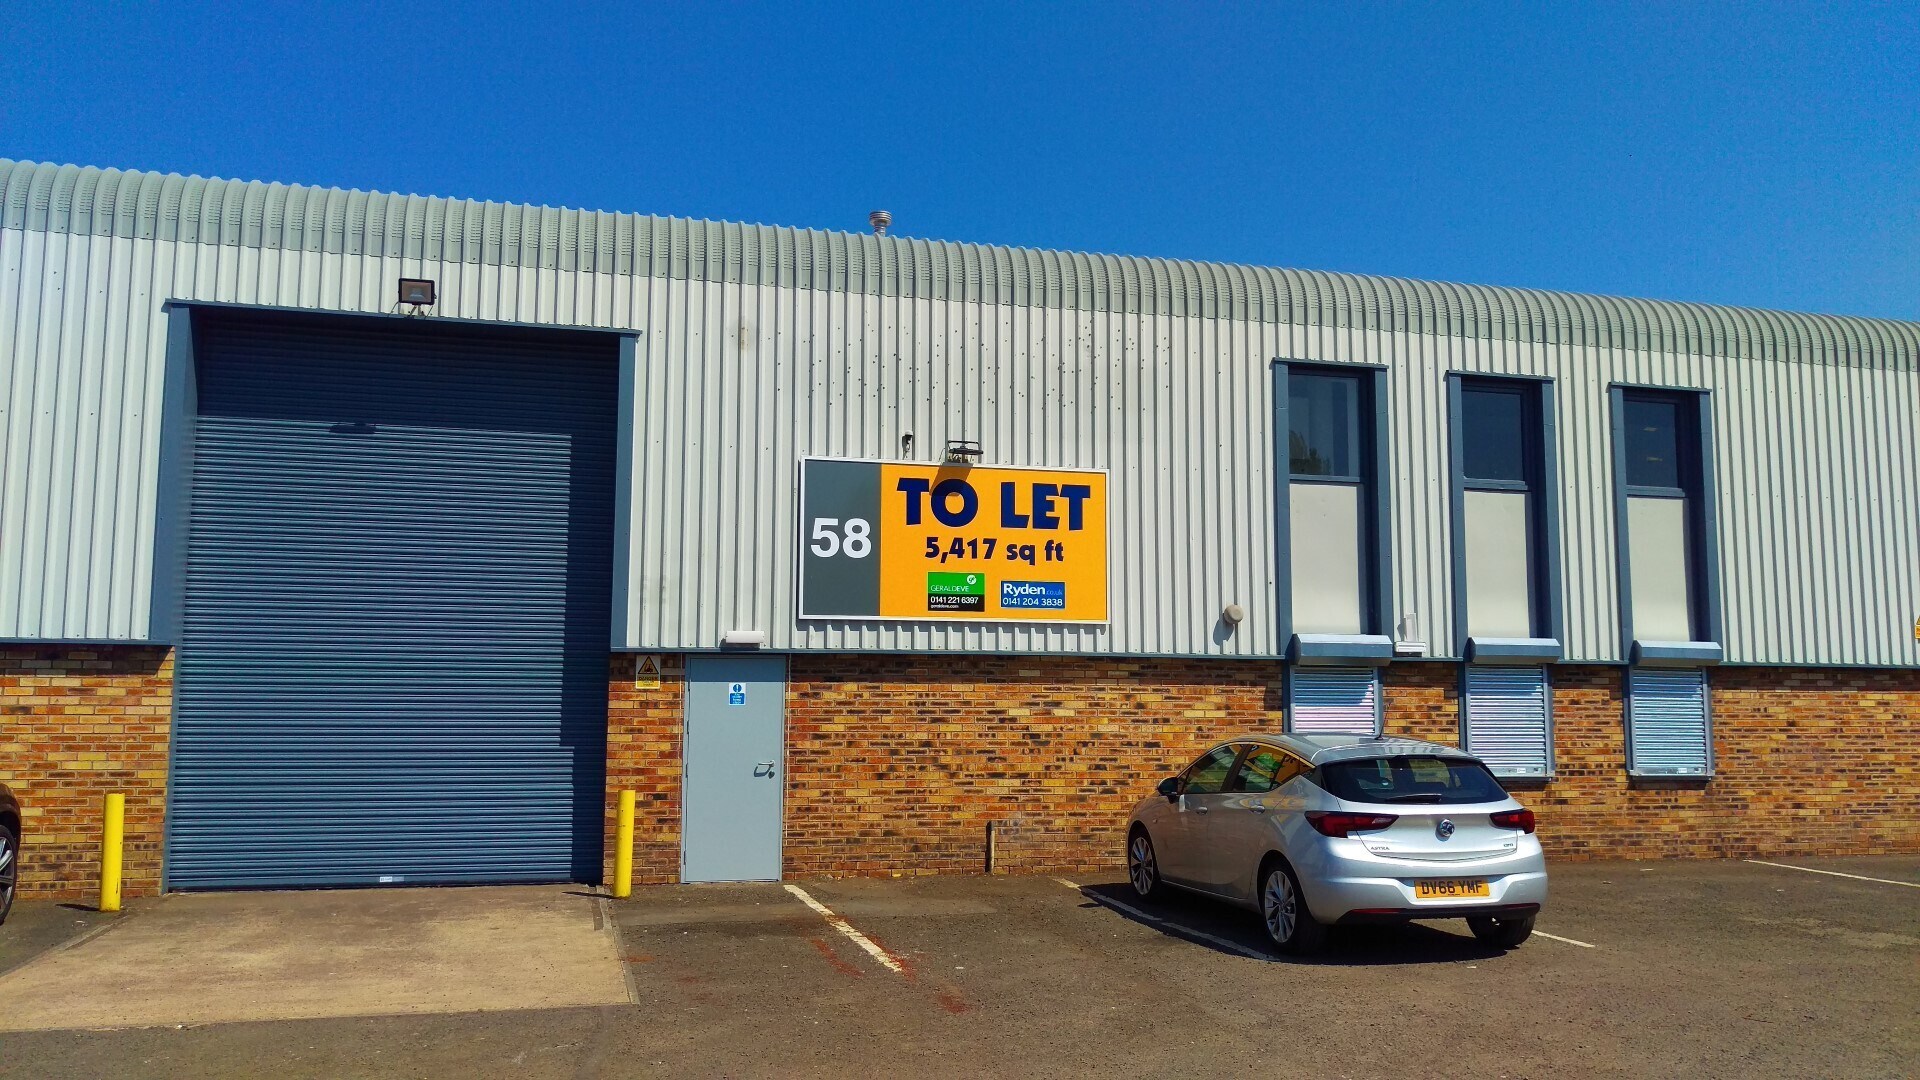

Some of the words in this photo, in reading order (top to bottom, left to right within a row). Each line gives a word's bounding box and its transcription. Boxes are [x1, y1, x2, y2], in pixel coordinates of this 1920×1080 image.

[897, 478, 978, 527] TO
[1001, 481, 1090, 531] LET
[810, 518, 872, 558] 58
[925, 536, 997, 563] 5,417
[1006, 543, 1035, 566] sq
[1045, 539, 1064, 561] ft
[930, 595, 947, 604] 0141
[947, 596, 960, 604] 221
[961, 596, 979, 604] 6397
[1002, 597, 1021, 605] 0141
[1022, 597, 1039, 606] 204
[1041, 598, 1063, 607] 3838
[1421, 880, 1455, 895] DV66
[1458, 880, 1482, 894] YMF
